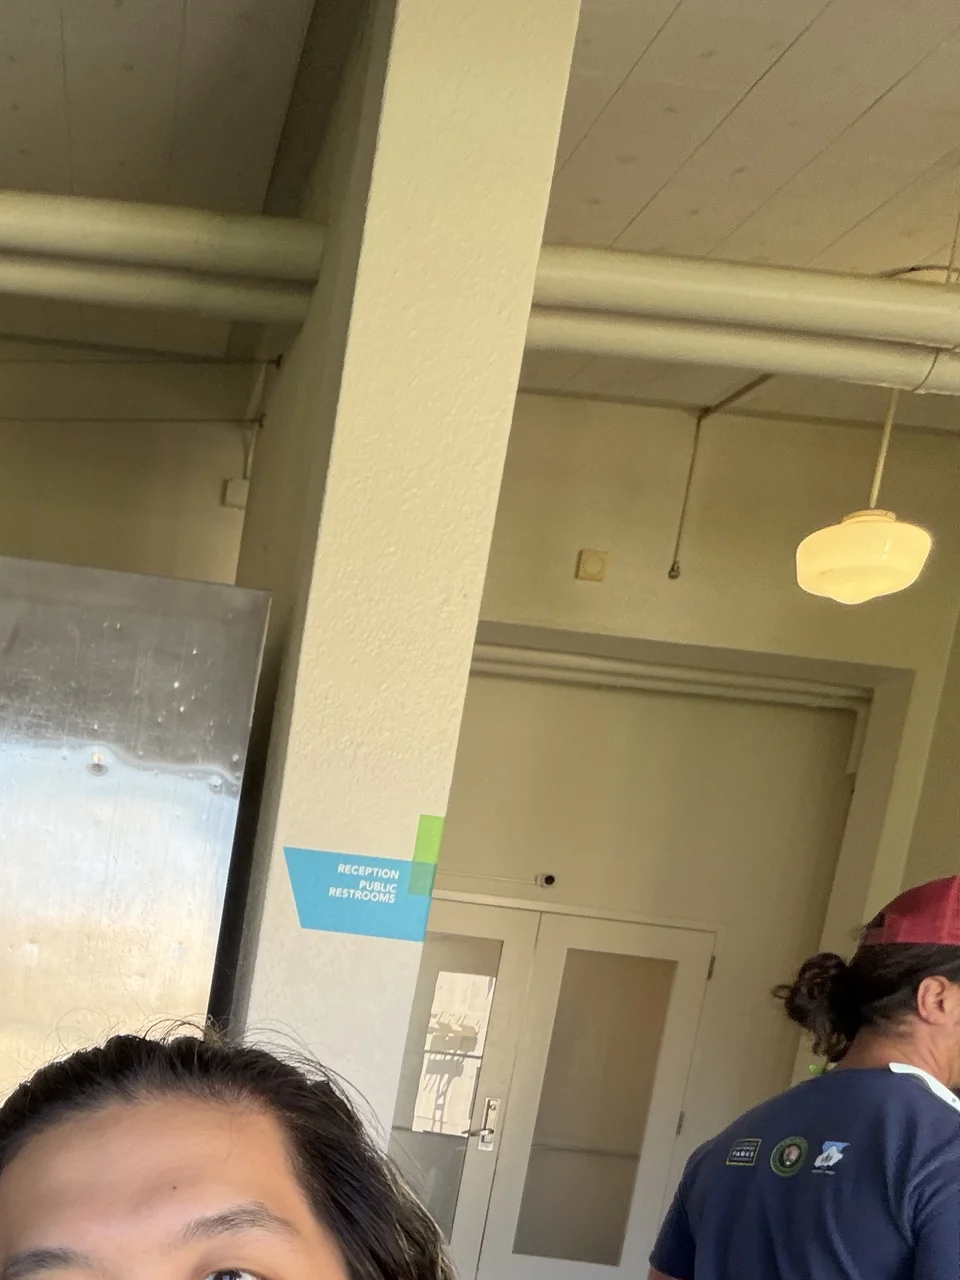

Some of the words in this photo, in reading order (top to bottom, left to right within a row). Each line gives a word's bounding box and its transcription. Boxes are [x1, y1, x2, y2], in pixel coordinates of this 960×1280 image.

[337, 863, 400, 880] RECEPTION
[359, 880, 397, 893] PUBLIC
[329, 887, 396, 904] RESTROOMS
